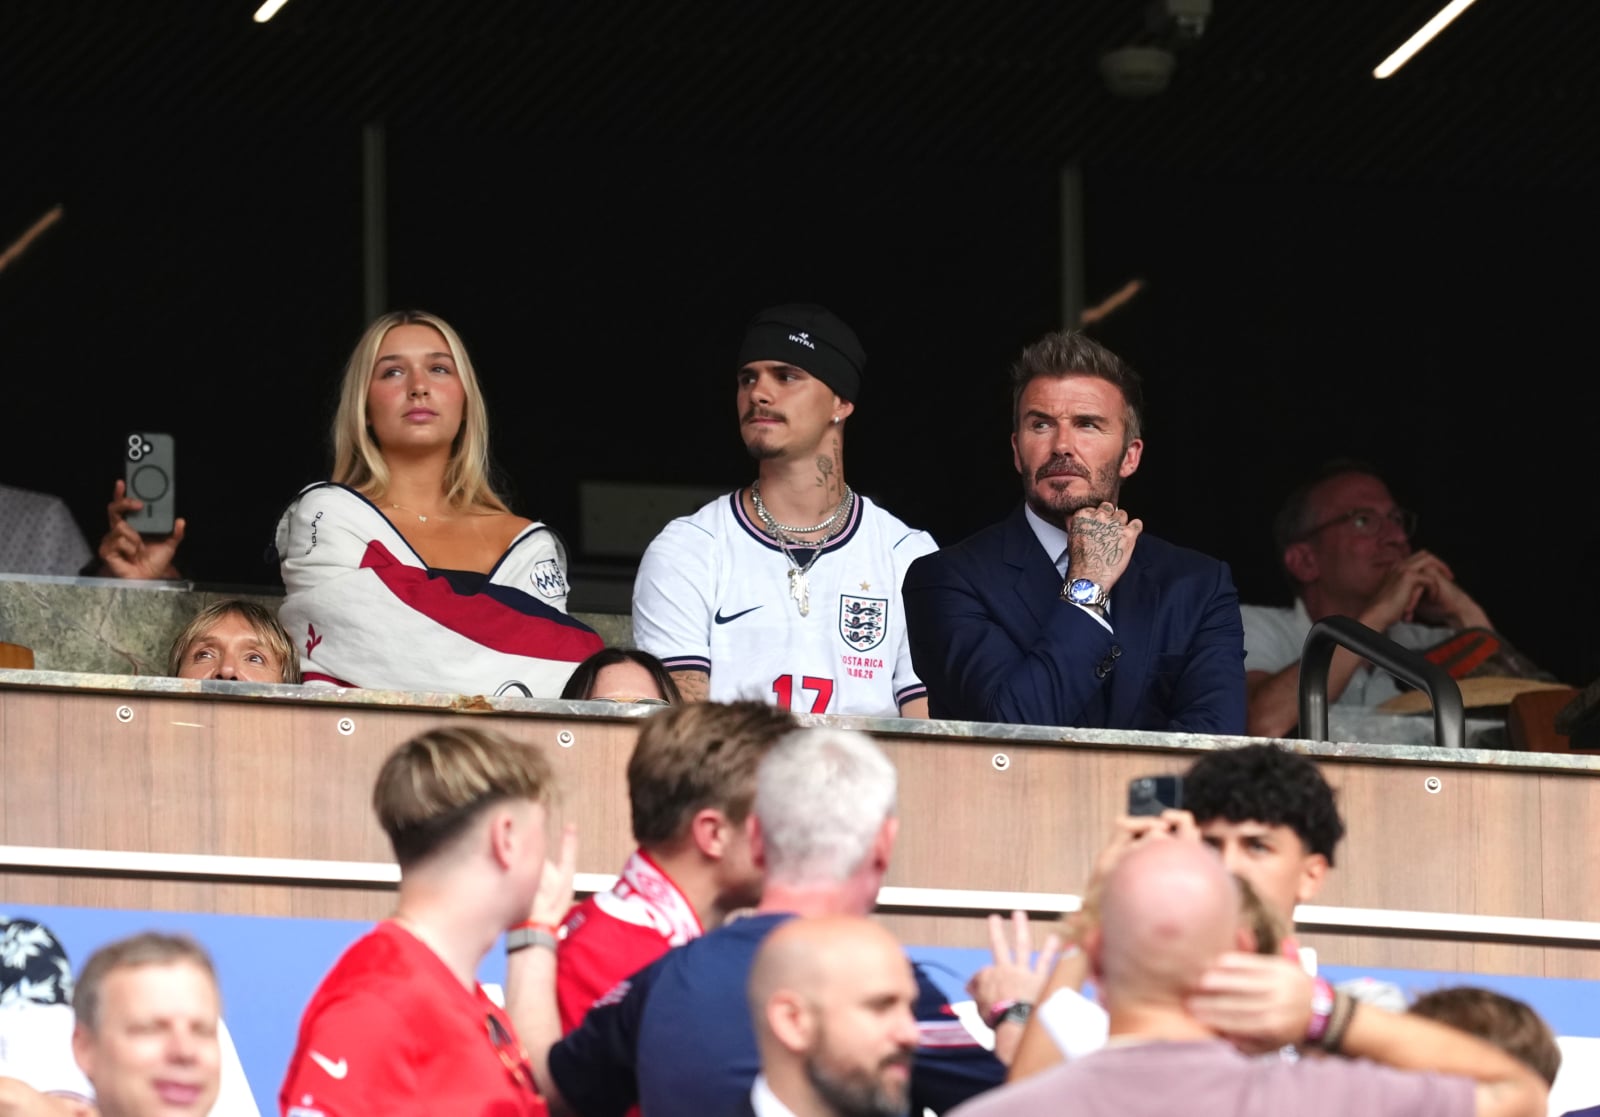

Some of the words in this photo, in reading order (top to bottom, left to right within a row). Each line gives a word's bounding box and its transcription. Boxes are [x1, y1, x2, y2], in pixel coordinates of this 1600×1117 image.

[788, 333, 815, 350] INTRA
[840, 654, 862, 667] OSTA
[864, 657, 883, 669] RICA
[772, 674, 833, 714] 17
